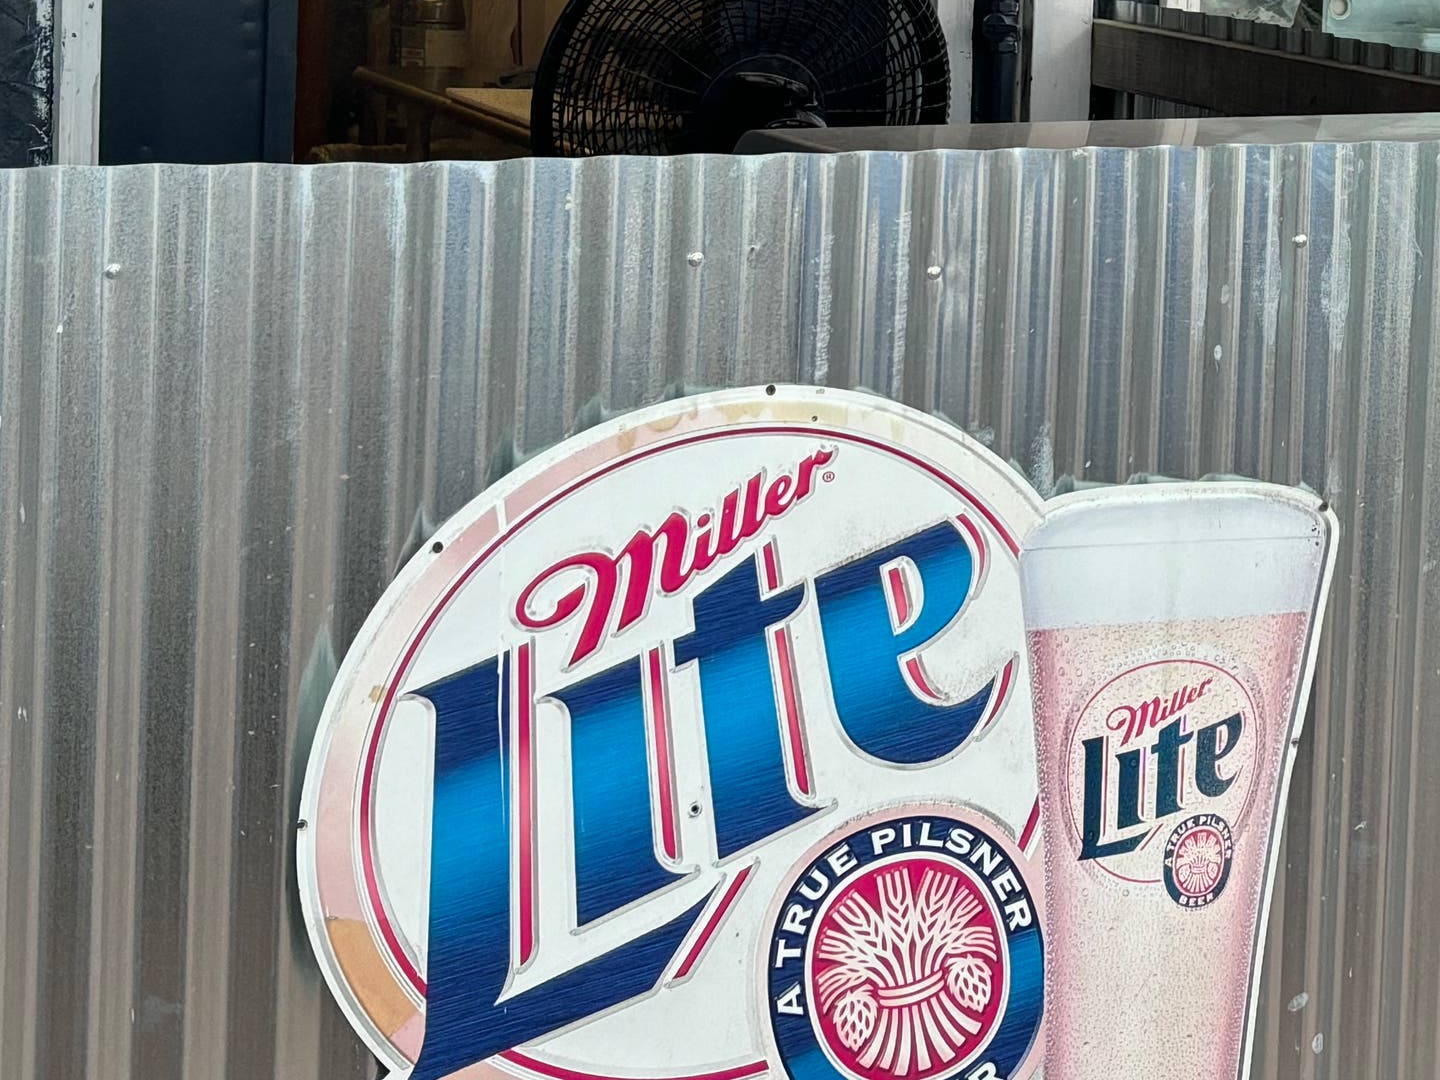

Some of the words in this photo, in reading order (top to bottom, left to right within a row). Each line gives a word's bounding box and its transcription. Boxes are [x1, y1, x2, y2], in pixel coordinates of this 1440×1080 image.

[515, 449, 834, 666] Miller
[1107, 676, 1213, 748] Miller
[402, 515, 1014, 1080] Lite
[1077, 709, 1246, 862] Lite
[1164, 856, 1173, 868] A
[1166, 818, 1196, 852] TRUE
[1199, 815, 1232, 859] PILSNER
[775, 845, 858, 968] TRUE
[871, 822, 1032, 932] PILSNER
[1179, 892, 1215, 906] BEER
[777, 984, 804, 1016] A
